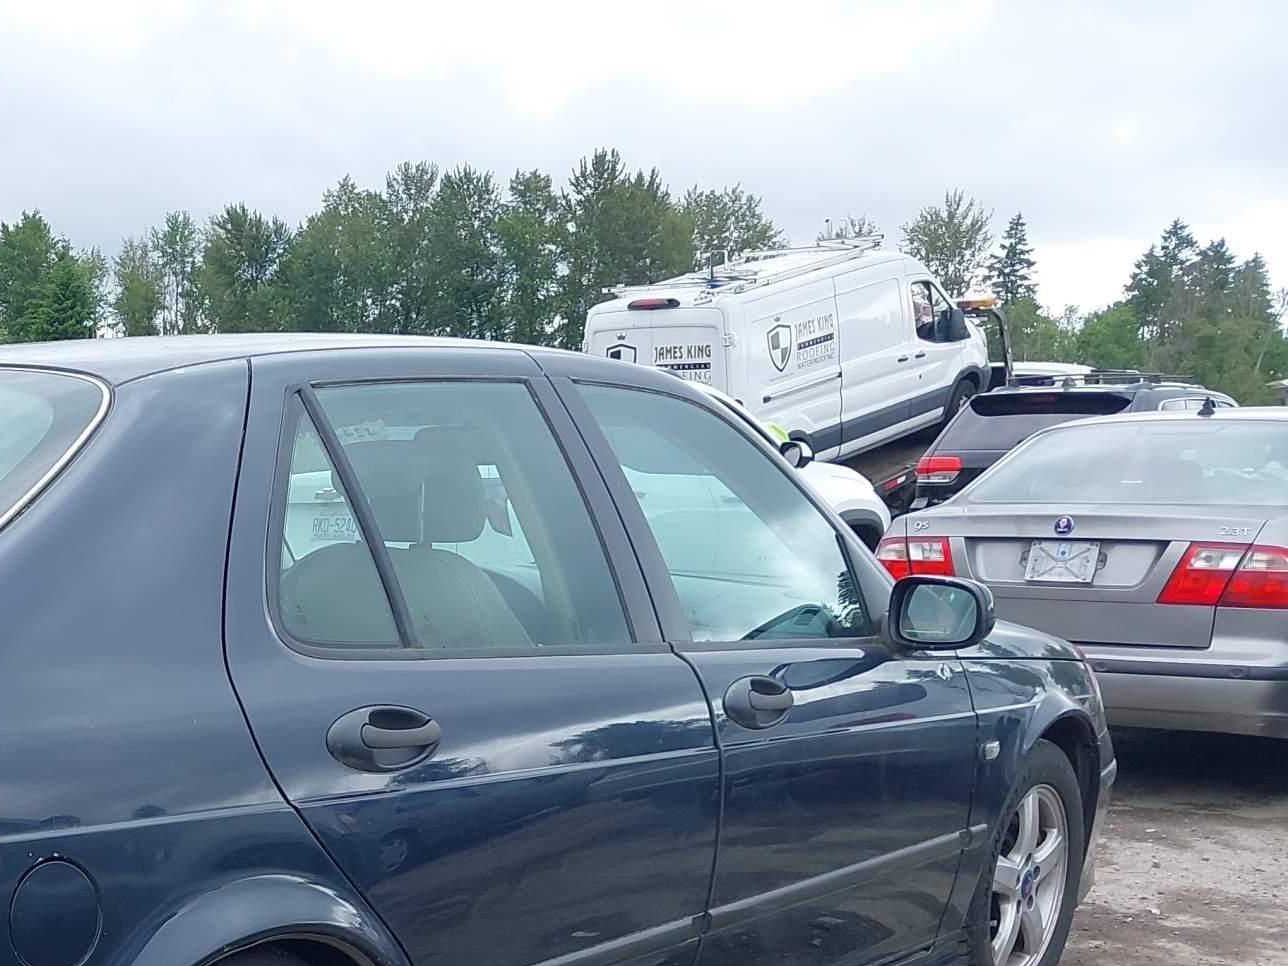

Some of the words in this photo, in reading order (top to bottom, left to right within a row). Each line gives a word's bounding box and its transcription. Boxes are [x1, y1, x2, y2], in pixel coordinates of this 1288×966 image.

[795, 319, 815, 341] JAMES
[817, 313, 834, 333] KING
[654, 345, 683, 363] JAMES
[687, 344, 712, 359] KING
[797, 341, 834, 361] ROOFING
